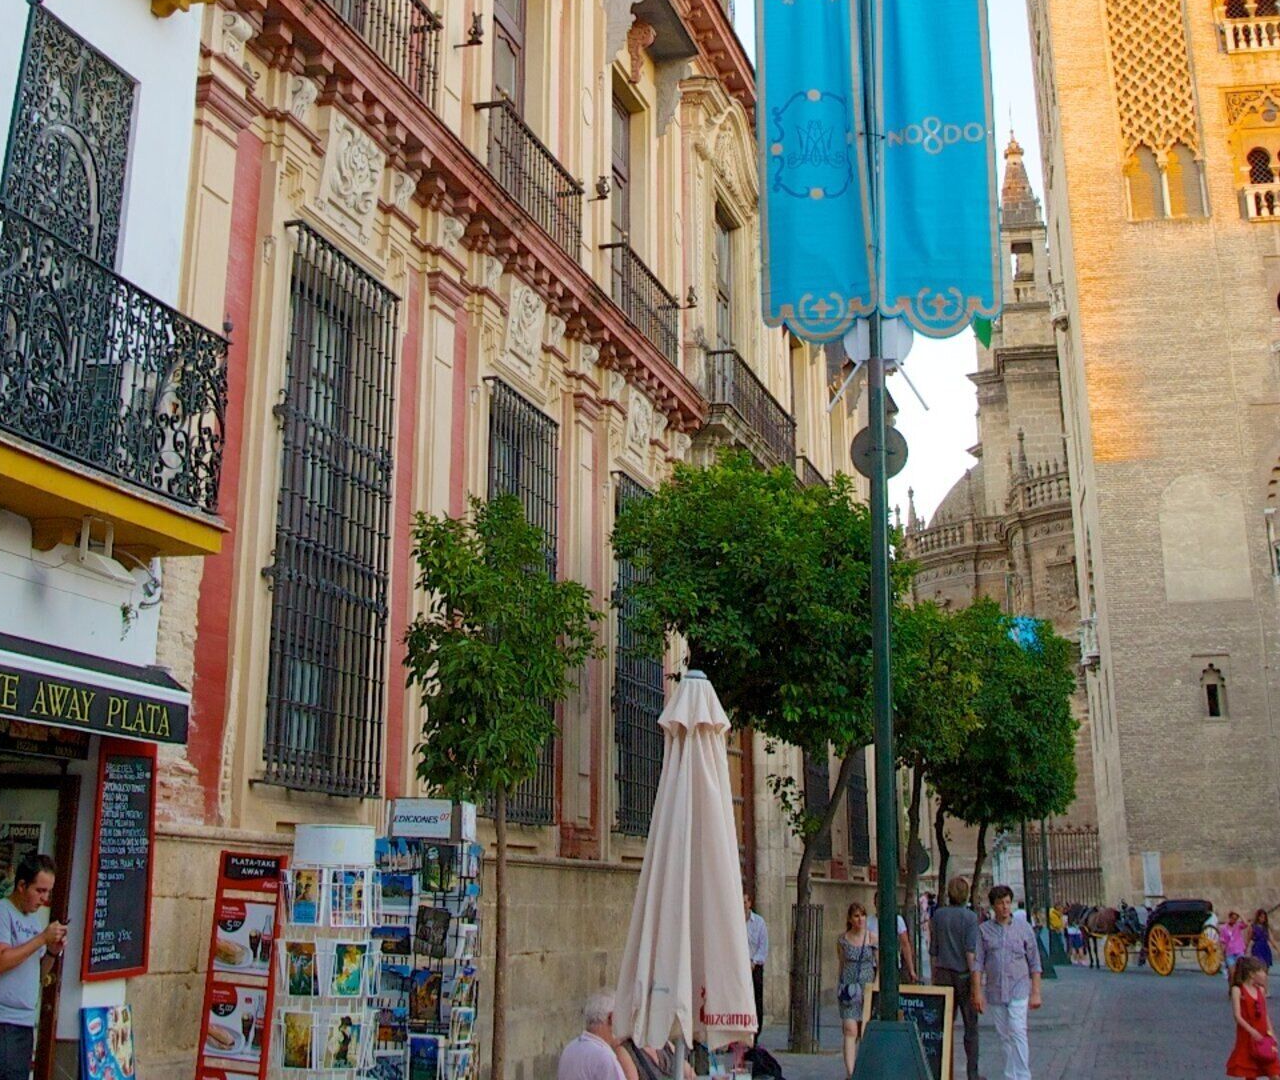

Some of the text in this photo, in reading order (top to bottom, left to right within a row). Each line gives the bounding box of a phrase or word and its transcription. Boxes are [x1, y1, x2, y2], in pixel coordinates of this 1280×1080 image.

[31, 683, 96, 722] AWAY
[107, 695, 170, 737] PLATA
[394, 814, 438, 824] EDICIONES
[231, 857, 276, 868] PLATA-TAKE
[241, 868, 264, 876] AWAY
